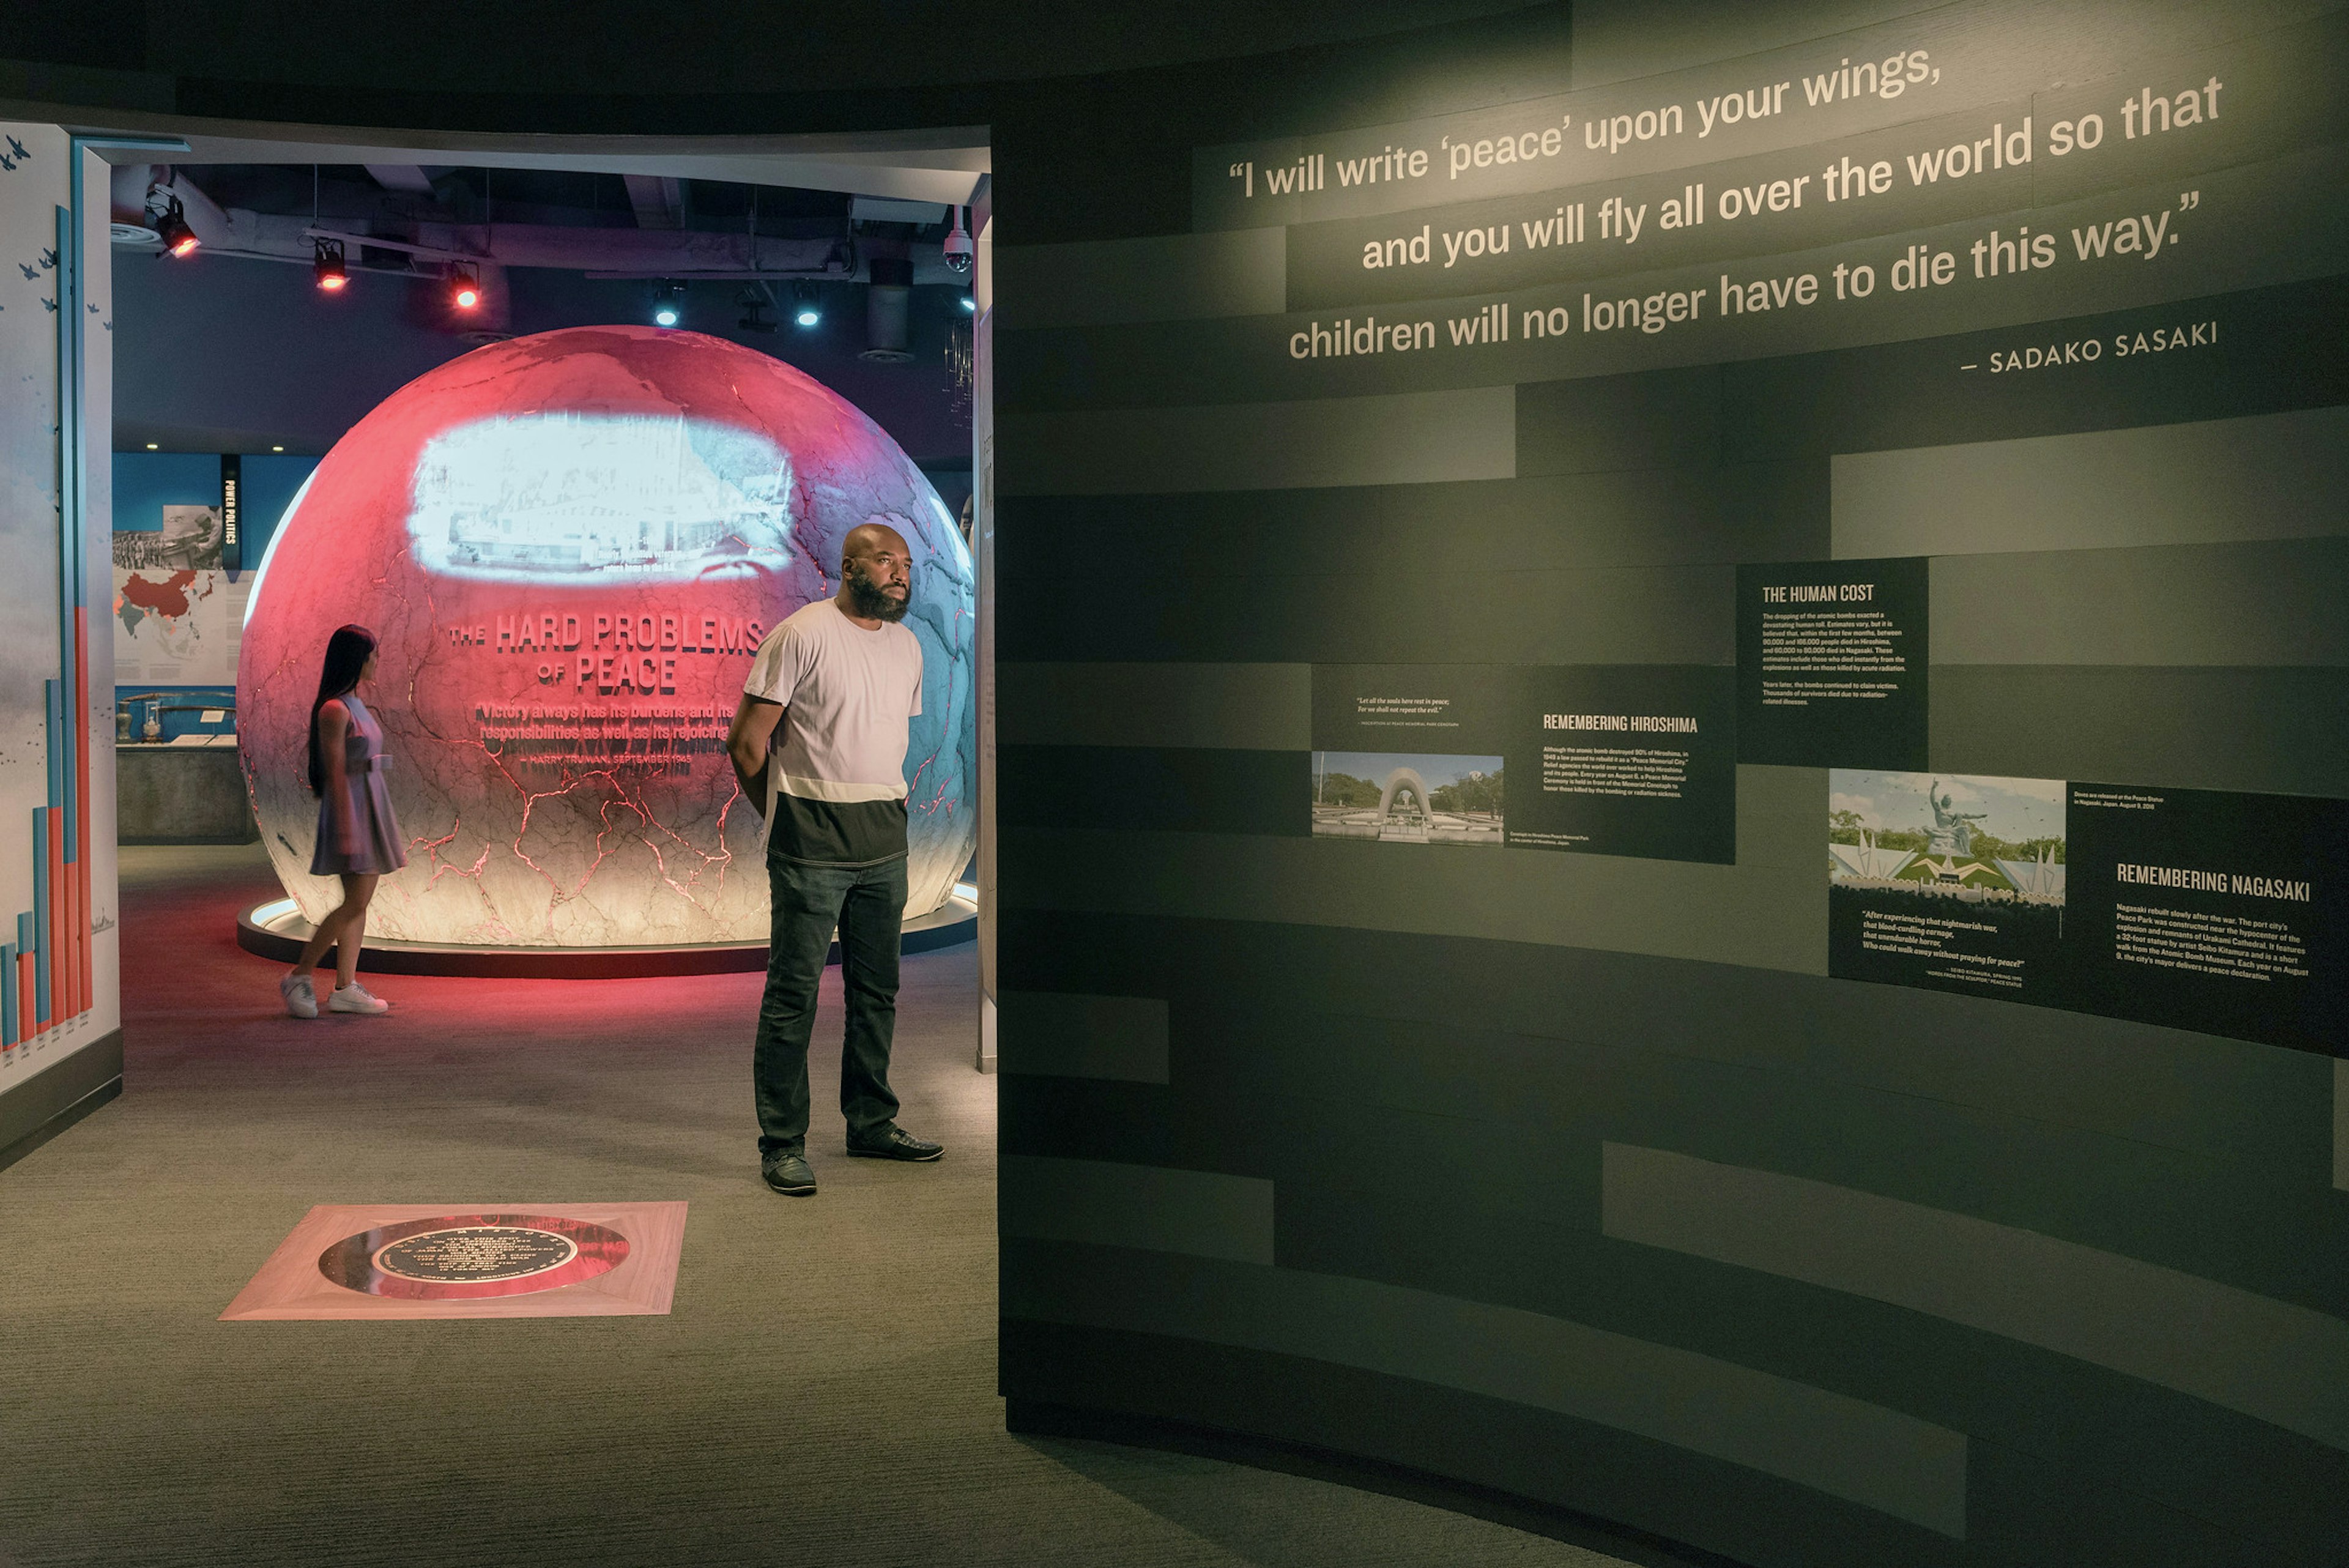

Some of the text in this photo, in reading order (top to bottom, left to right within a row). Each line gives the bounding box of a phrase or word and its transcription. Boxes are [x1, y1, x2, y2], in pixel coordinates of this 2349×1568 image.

[1230, 51, 1940, 198] “I will write ‘peace’ upon your wings,
[1364, 77, 2222, 269] and you will fly all over the world so that
[1291, 191, 2199, 358] children will no longer have to die this way.”
[1991, 340, 2101, 373] SADAKO
[2116, 322, 2216, 356] SASAKI
[225, 480, 236, 544] POWER POLITICS
[1763, 584, 1874, 602] THE HUMAN COST
[450, 613, 763, 652] THE HARD PROBLEMS
[538, 653, 675, 688] OF PEACE
[532, 705, 579, 721] always
[582, 704, 607, 718] has
[610, 704, 627, 718] its
[631, 704, 686, 718] burdens
[690, 704, 713, 718] and
[718, 704, 733, 718] its
[1544, 715, 1697, 732] REMEMBERING HIROSHIMA
[480, 724, 579, 741] responsibilities
[584, 727, 600, 739] as
[602, 724, 629, 739] well
[634, 727, 648, 739] as
[653, 724, 669, 739] its
[613, 755, 669, 764] SEPTEMBER
[2118, 863, 2309, 901] REMEMBERING NAGASAKI
[1878, 922, 1925, 936] blood-curdling
[1926, 929, 1954, 938] carnage,
[1883, 915, 1926, 926] experiencing
[1942, 920, 1982, 930] nightmarish
[2117, 904, 2147, 913] Nagasaki
[2170, 910, 2191, 920] slowly
[2239, 918, 2252, 926] The
[2269, 923, 2287, 931] city’s
[2117, 913, 2136, 922] Peace
[2169, 921, 2208, 931] constructed
[2240, 929, 2278, 940] hypocenter
[1919, 937, 1941, 947] horror,
[2122, 933, 2146, 943] 32-foot
[2218, 946, 2249, 957] Kitamura
[2279, 955, 2298, 964] short
[2162, 930, 2193, 939] remnants
[2203, 934, 2231, 944] Urakami
[2232, 938, 2267, 949] Cathedral.
[2276, 944, 2306, 954] features
[1933, 950, 1959, 959] without
[1960, 954, 1986, 965] praying
[2161, 949, 2183, 958] Atomic
[2185, 951, 2205, 960] Bomb
[2205, 955, 2236, 965] Museum.
[2238, 959, 2255, 968] Each
[2284, 966, 2309, 976] August
[2176, 961, 2202, 971] delivers
[2230, 969, 2270, 981] declaration.
